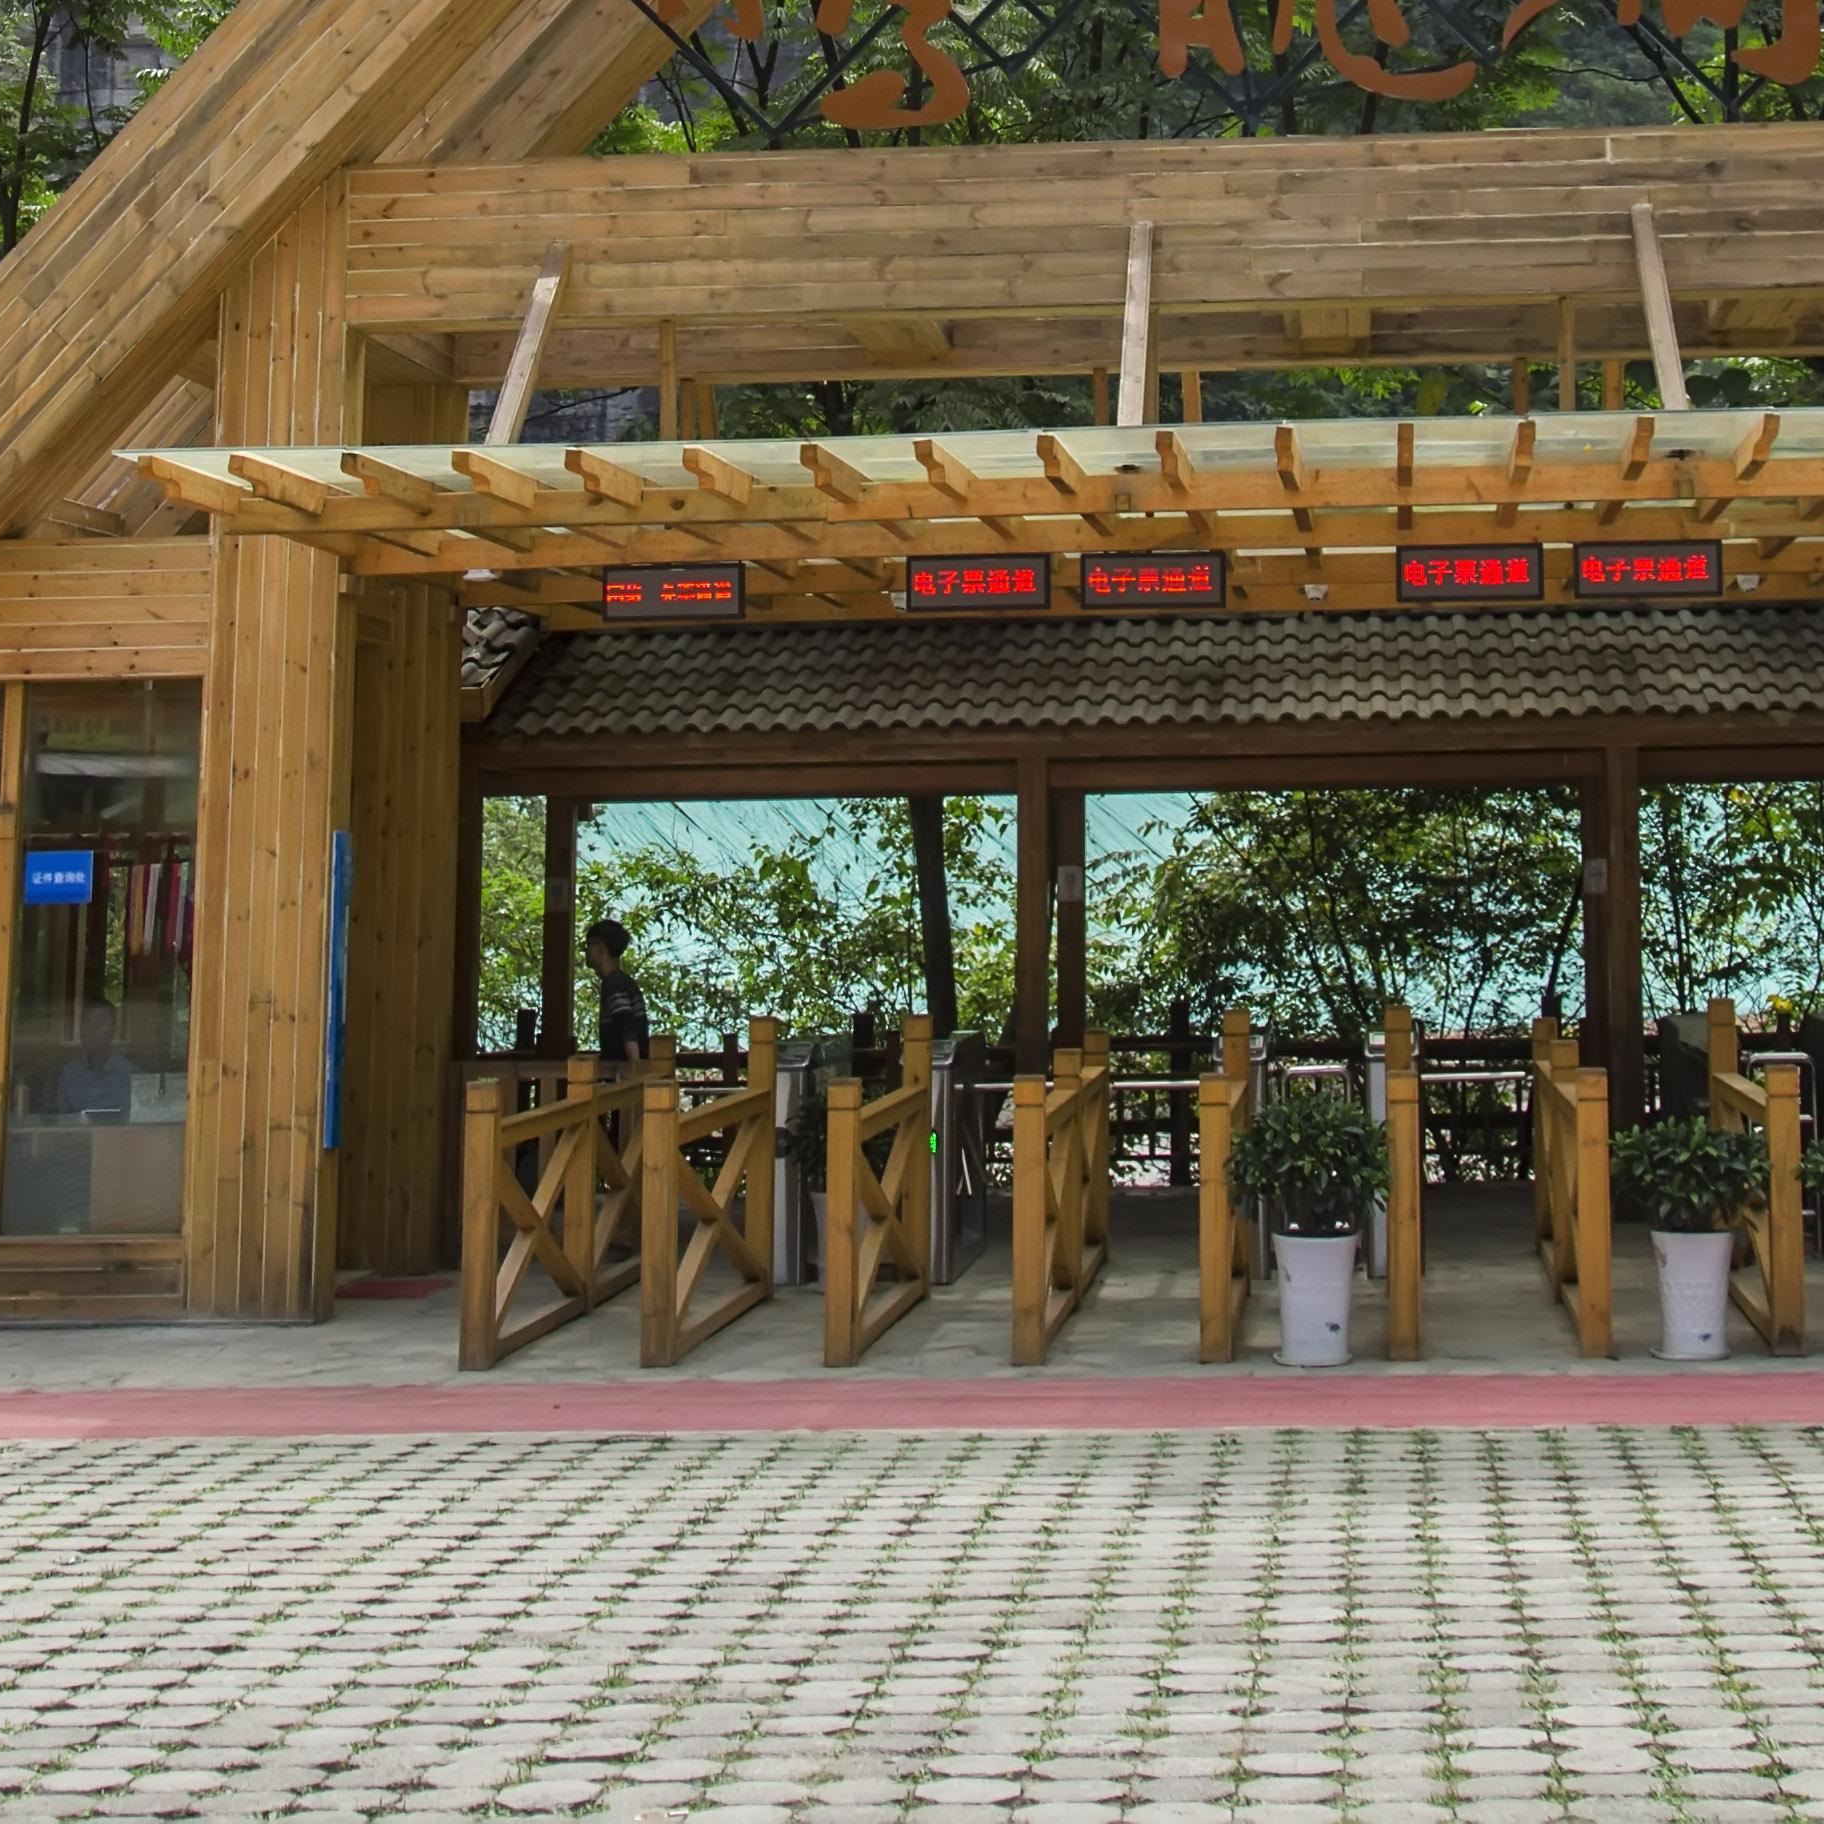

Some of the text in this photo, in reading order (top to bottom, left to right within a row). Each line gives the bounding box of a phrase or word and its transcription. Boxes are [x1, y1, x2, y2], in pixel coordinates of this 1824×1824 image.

[913, 569, 1037, 595] 电子票通道
[1088, 565, 1212, 594] 电子票通道
[1404, 557, 1530, 587] 电子票通道
[1581, 554, 1710, 583] 电子票通道
